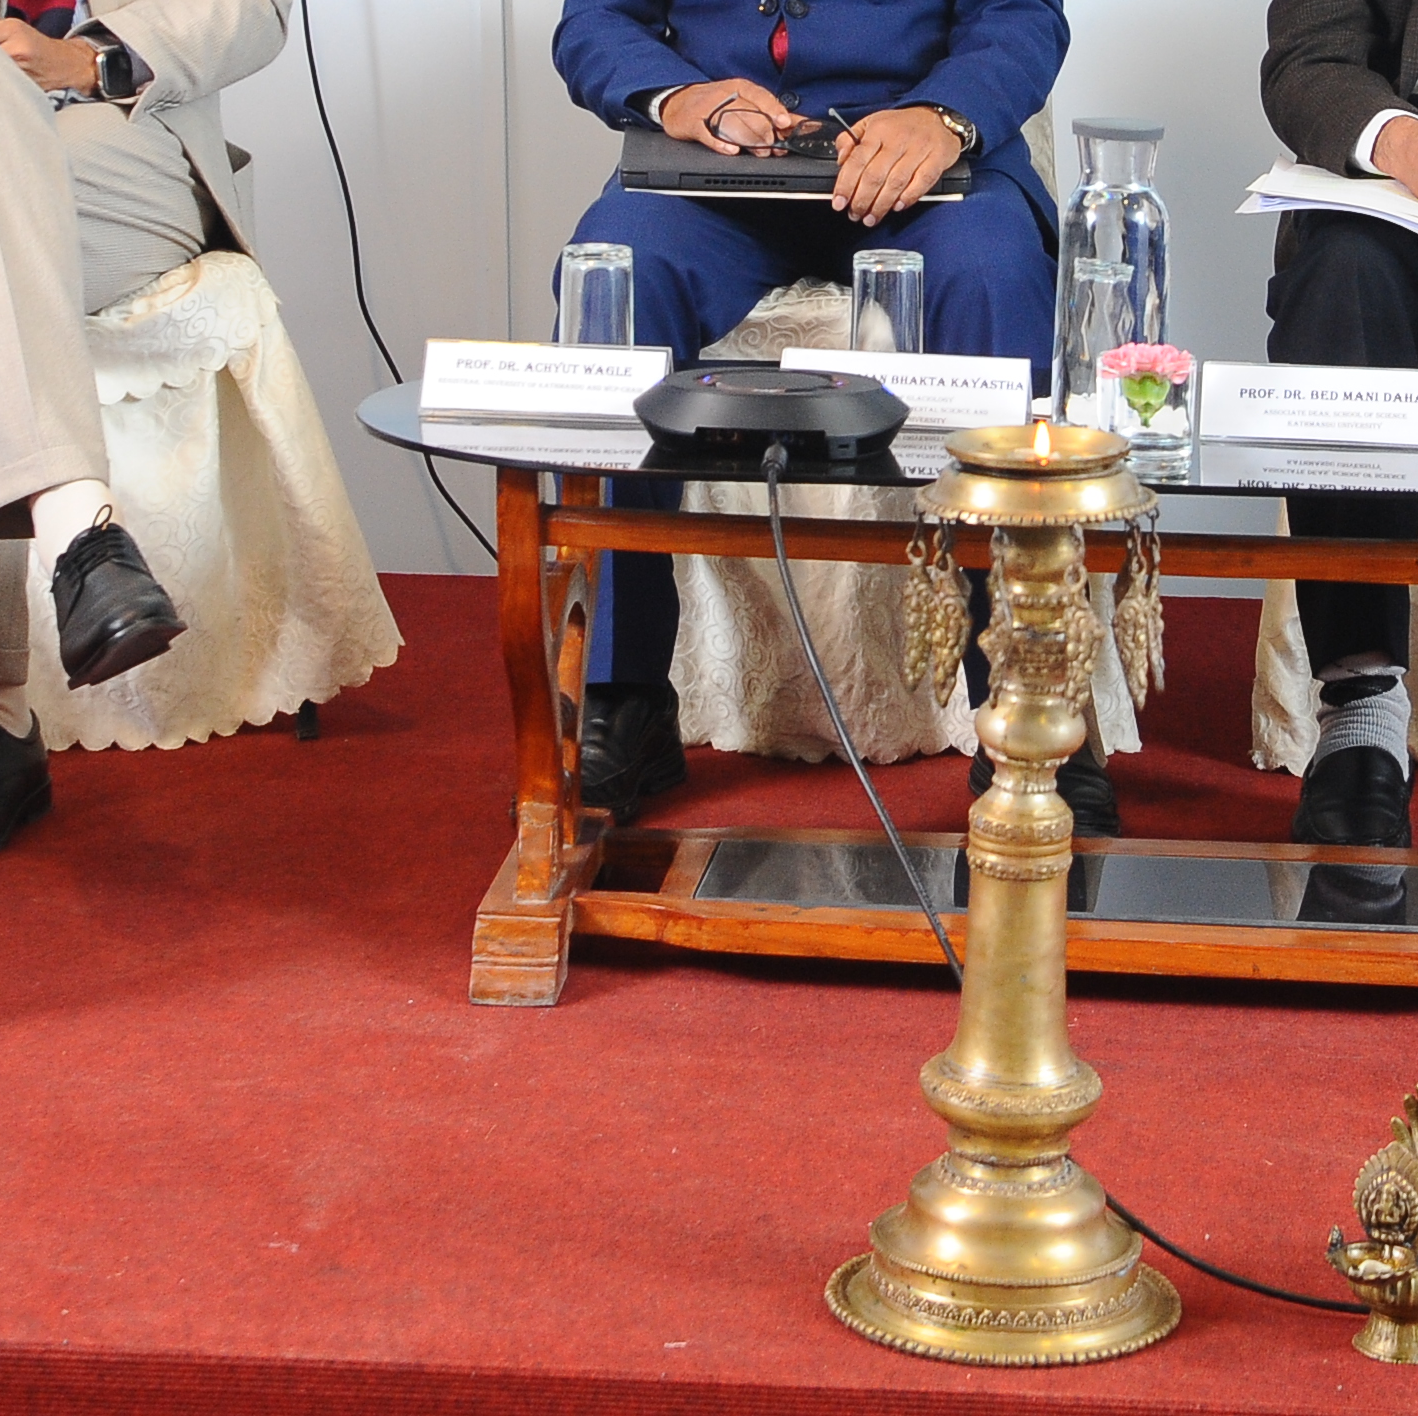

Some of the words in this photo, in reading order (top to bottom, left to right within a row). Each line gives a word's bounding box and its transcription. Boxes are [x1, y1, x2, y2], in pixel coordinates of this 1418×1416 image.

[455, 357, 494, 371] PROF.
[498, 359, 520, 372] DR.
[524, 361, 580, 375] ACHYUT
[583, 363, 633, 378] WAGLE
[891, 374, 946, 387] BHAKTA
[951, 377, 1024, 391] KAYASTHA
[1239, 388, 1279, 399] PROF.
[1283, 389, 1305, 400] DR.
[1310, 390, 1339, 401] BED
[1342, 391, 1379, 402] MANI
[1263, 409, 1306, 417] ASSOCIATE
[1375, 412, 1408, 420] SCIENCE
[1337, 421, 1383, 430] UNIVERSITY
